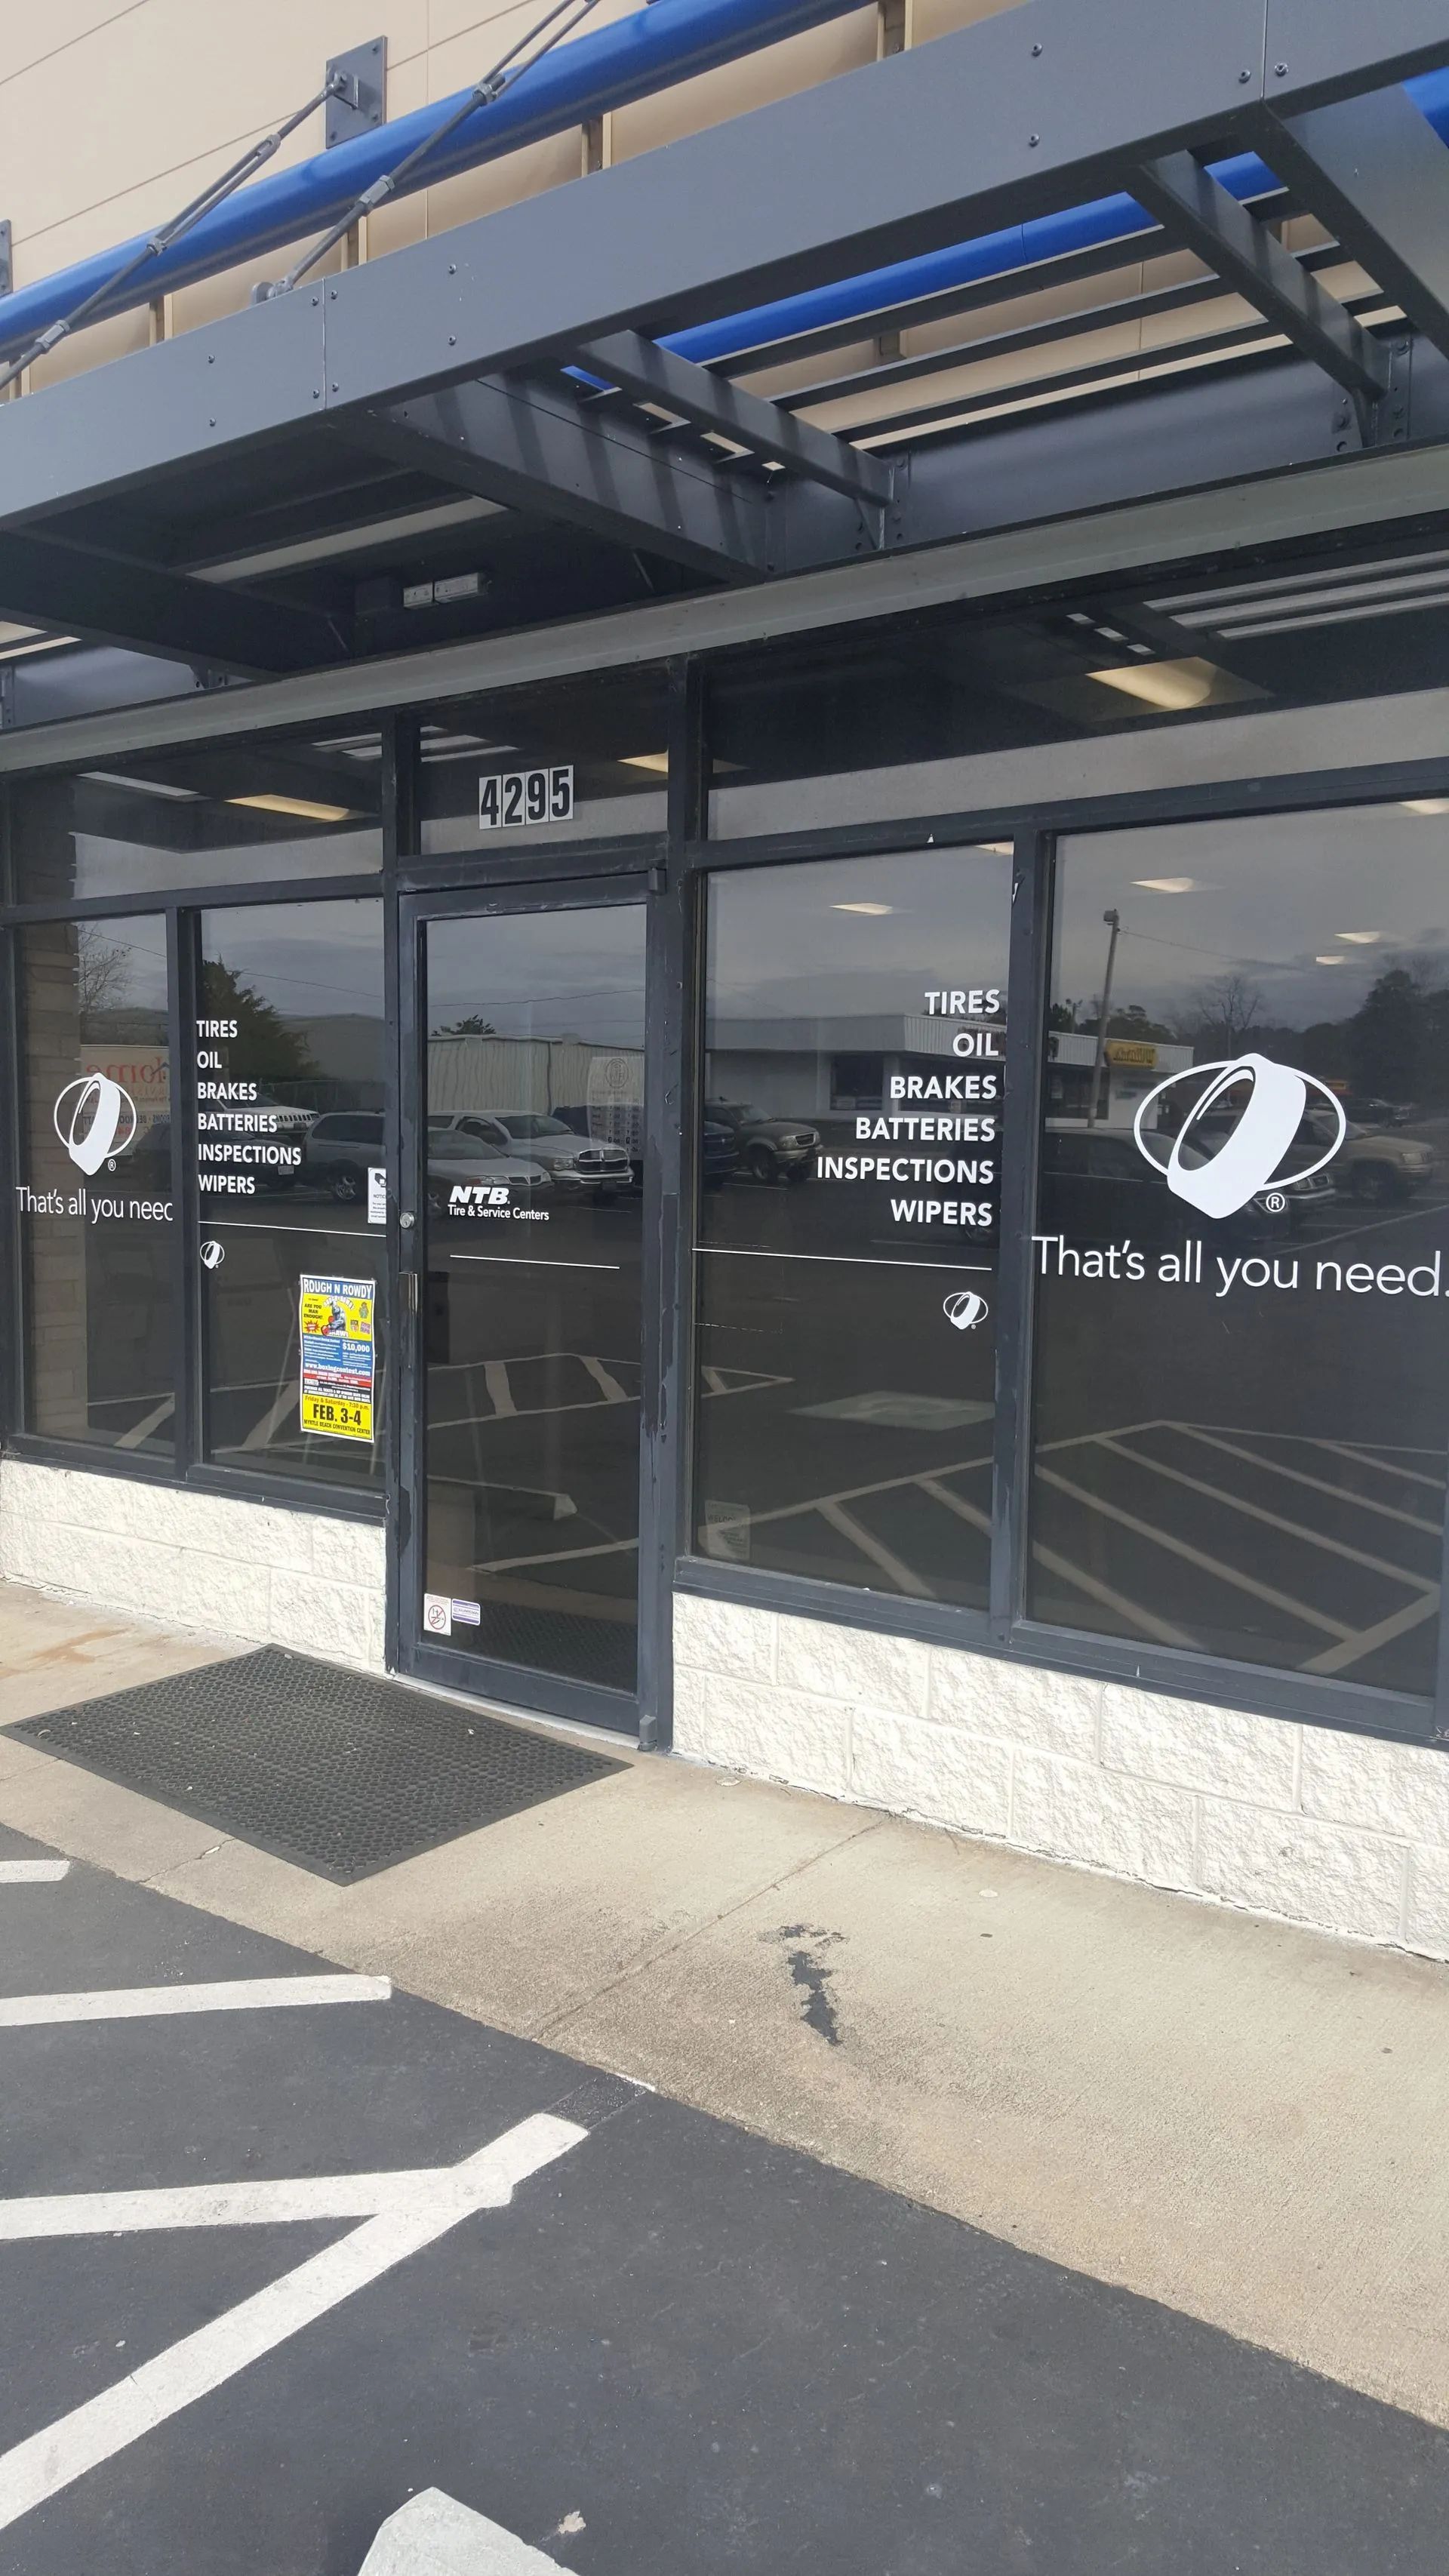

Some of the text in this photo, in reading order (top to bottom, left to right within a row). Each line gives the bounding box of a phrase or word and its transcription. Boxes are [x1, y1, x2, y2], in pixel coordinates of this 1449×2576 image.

[481, 768, 571, 826] 4295
[924, 989, 1000, 1015] TIRES
[196, 1020, 238, 1038] TIRES
[952, 1033, 999, 1057] OIL
[197, 1051, 223, 1069] OIL
[198, 1082, 257, 1101] BRAKES
[890, 1075, 997, 1100] BRAKES
[198, 1113, 278, 1133] BATTERIES
[856, 1117, 995, 1142] BATTERIES
[198, 1143, 302, 1165] INSPECTIONS
[817, 1156, 994, 1185] INSPECTIONS
[198, 1174, 255, 1194] WIPERS
[15, 1186, 64, 1214] That's
[68, 1188, 87, 1216] all
[91, 1199, 124, 1224] you
[448, 1186, 509, 1205] NTB
[448, 1204, 549, 1221] Tire & Service Centers
[891, 1199, 992, 1226] WIPERS
[1031, 1235, 1145, 1281] That's
[1158, 1240, 1202, 1283] all
[1215, 1257, 1298, 1297] you
[303, 1278, 372, 1299] ROUGH N ROWDY
[342, 1342, 371, 1353] $10,000
[325, 1398, 346, 1407] Saturday
[313, 1403, 361, 1426] FEB. 3-4
[332, 1423, 356, 1433] CONVENTION
